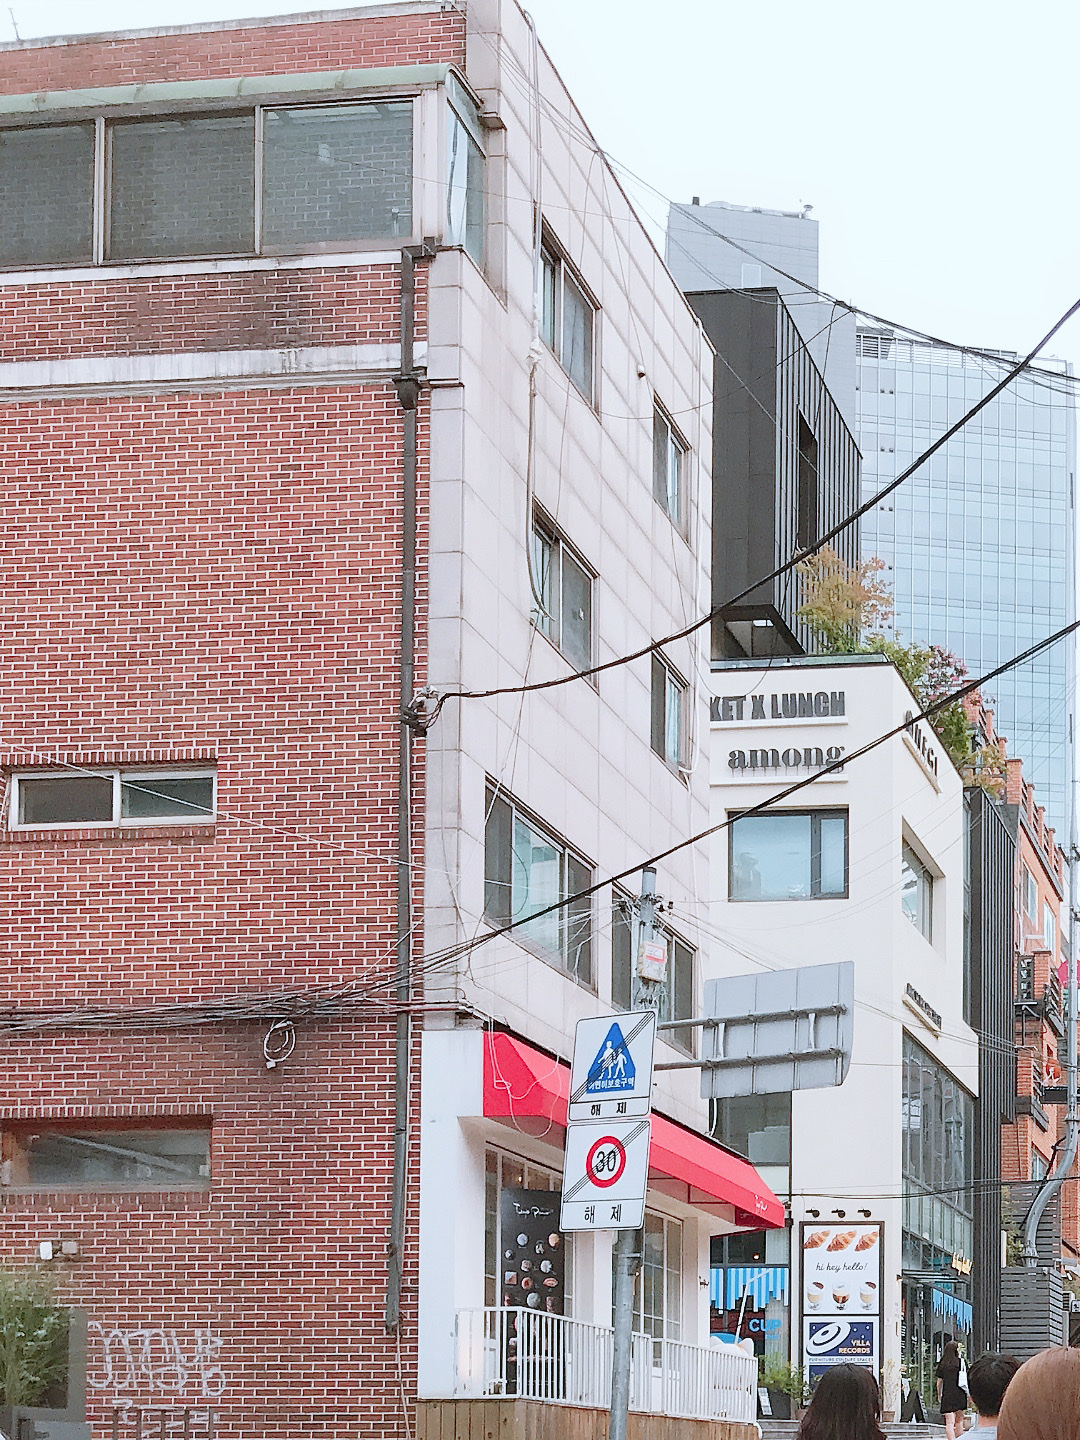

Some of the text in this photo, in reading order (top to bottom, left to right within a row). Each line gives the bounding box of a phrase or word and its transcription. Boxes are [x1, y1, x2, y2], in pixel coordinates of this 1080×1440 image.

[751, 694, 766, 720] X
[771, 691, 845, 719] LUNCH
[727, 745, 846, 775] among
[596, 1150, 616, 1173] 30
[816, 1262, 868, 1273] hi hey hello!
[749, 1318, 782, 1332] CUP
